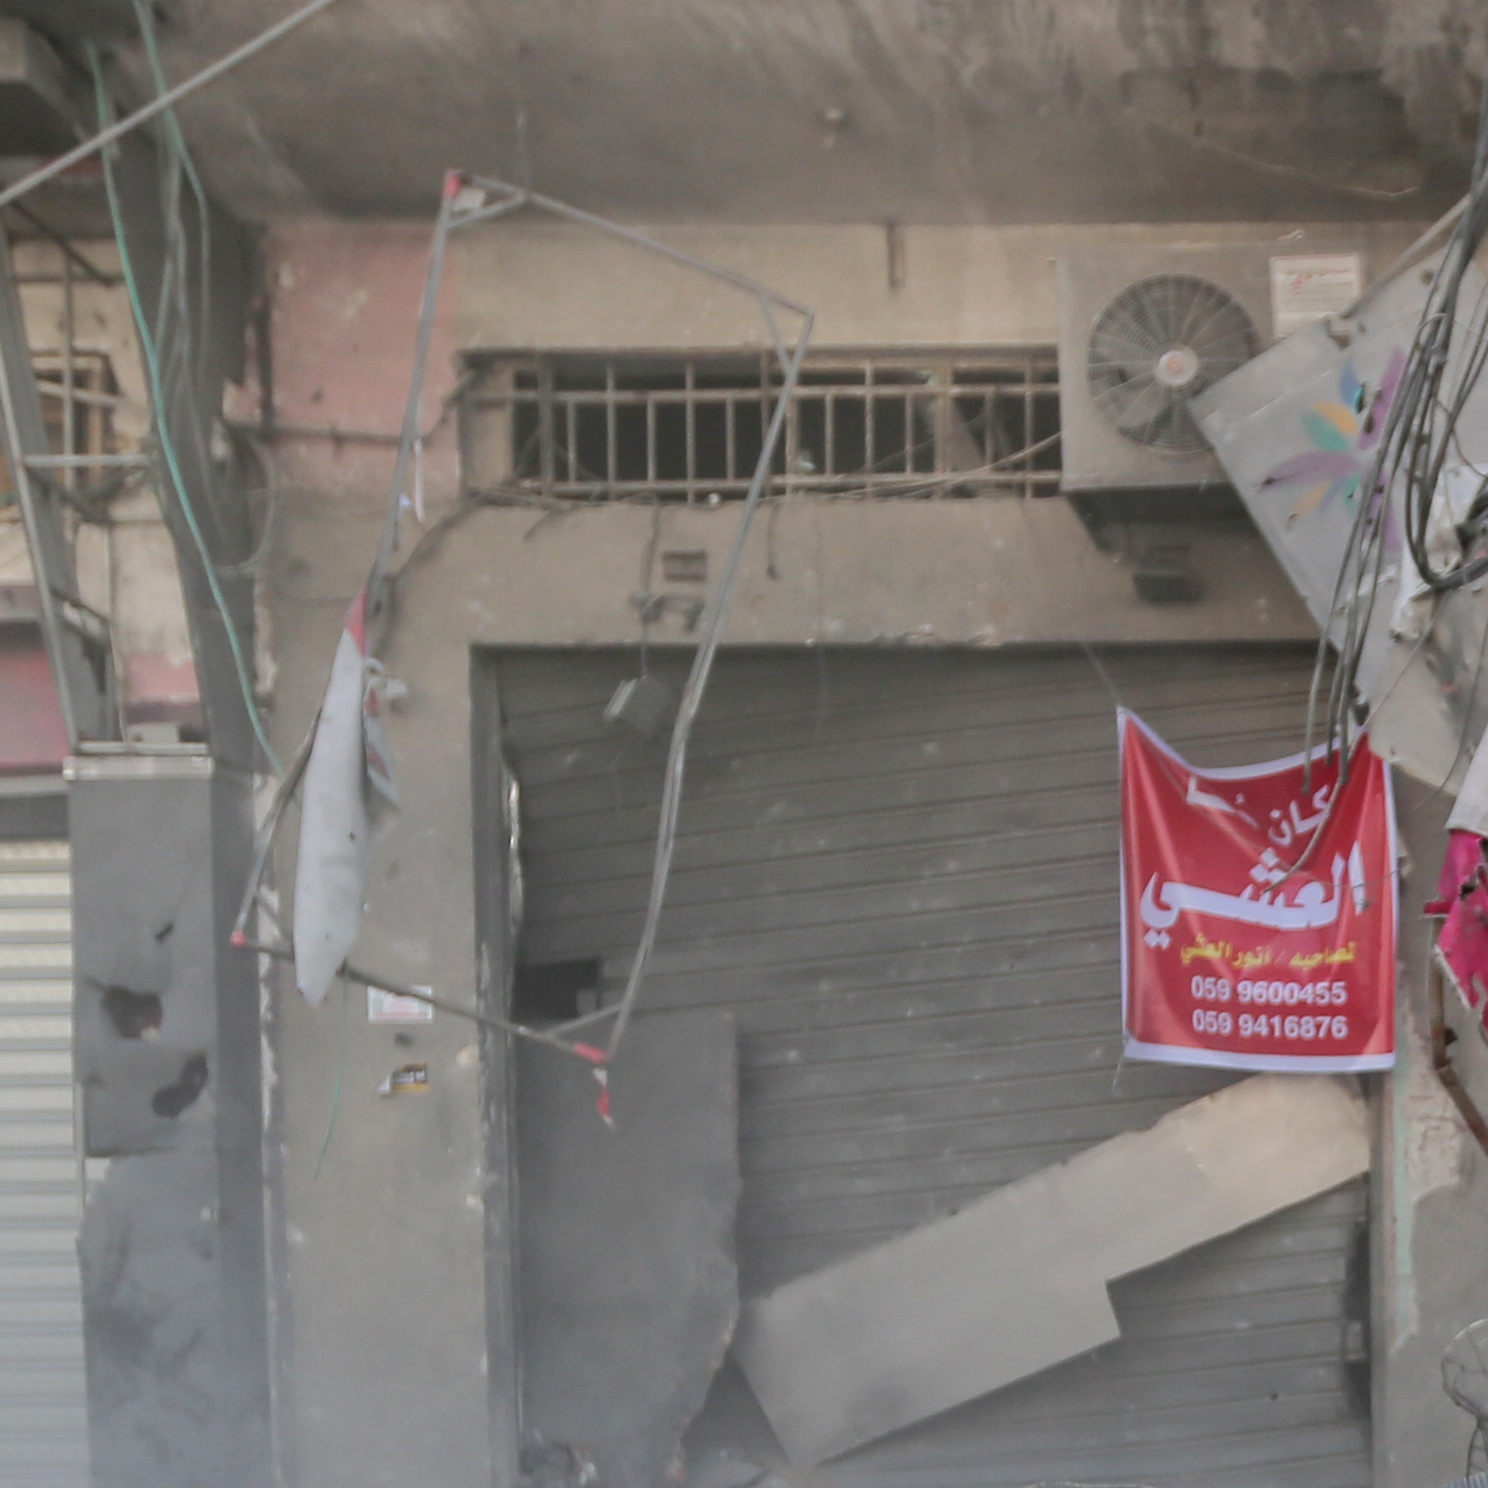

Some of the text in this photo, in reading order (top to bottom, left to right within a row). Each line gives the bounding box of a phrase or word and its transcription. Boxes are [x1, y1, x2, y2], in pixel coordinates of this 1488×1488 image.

[1191, 975, 1348, 1006] 059 9600455
[1192, 1008, 1349, 1041] 059 9416876
